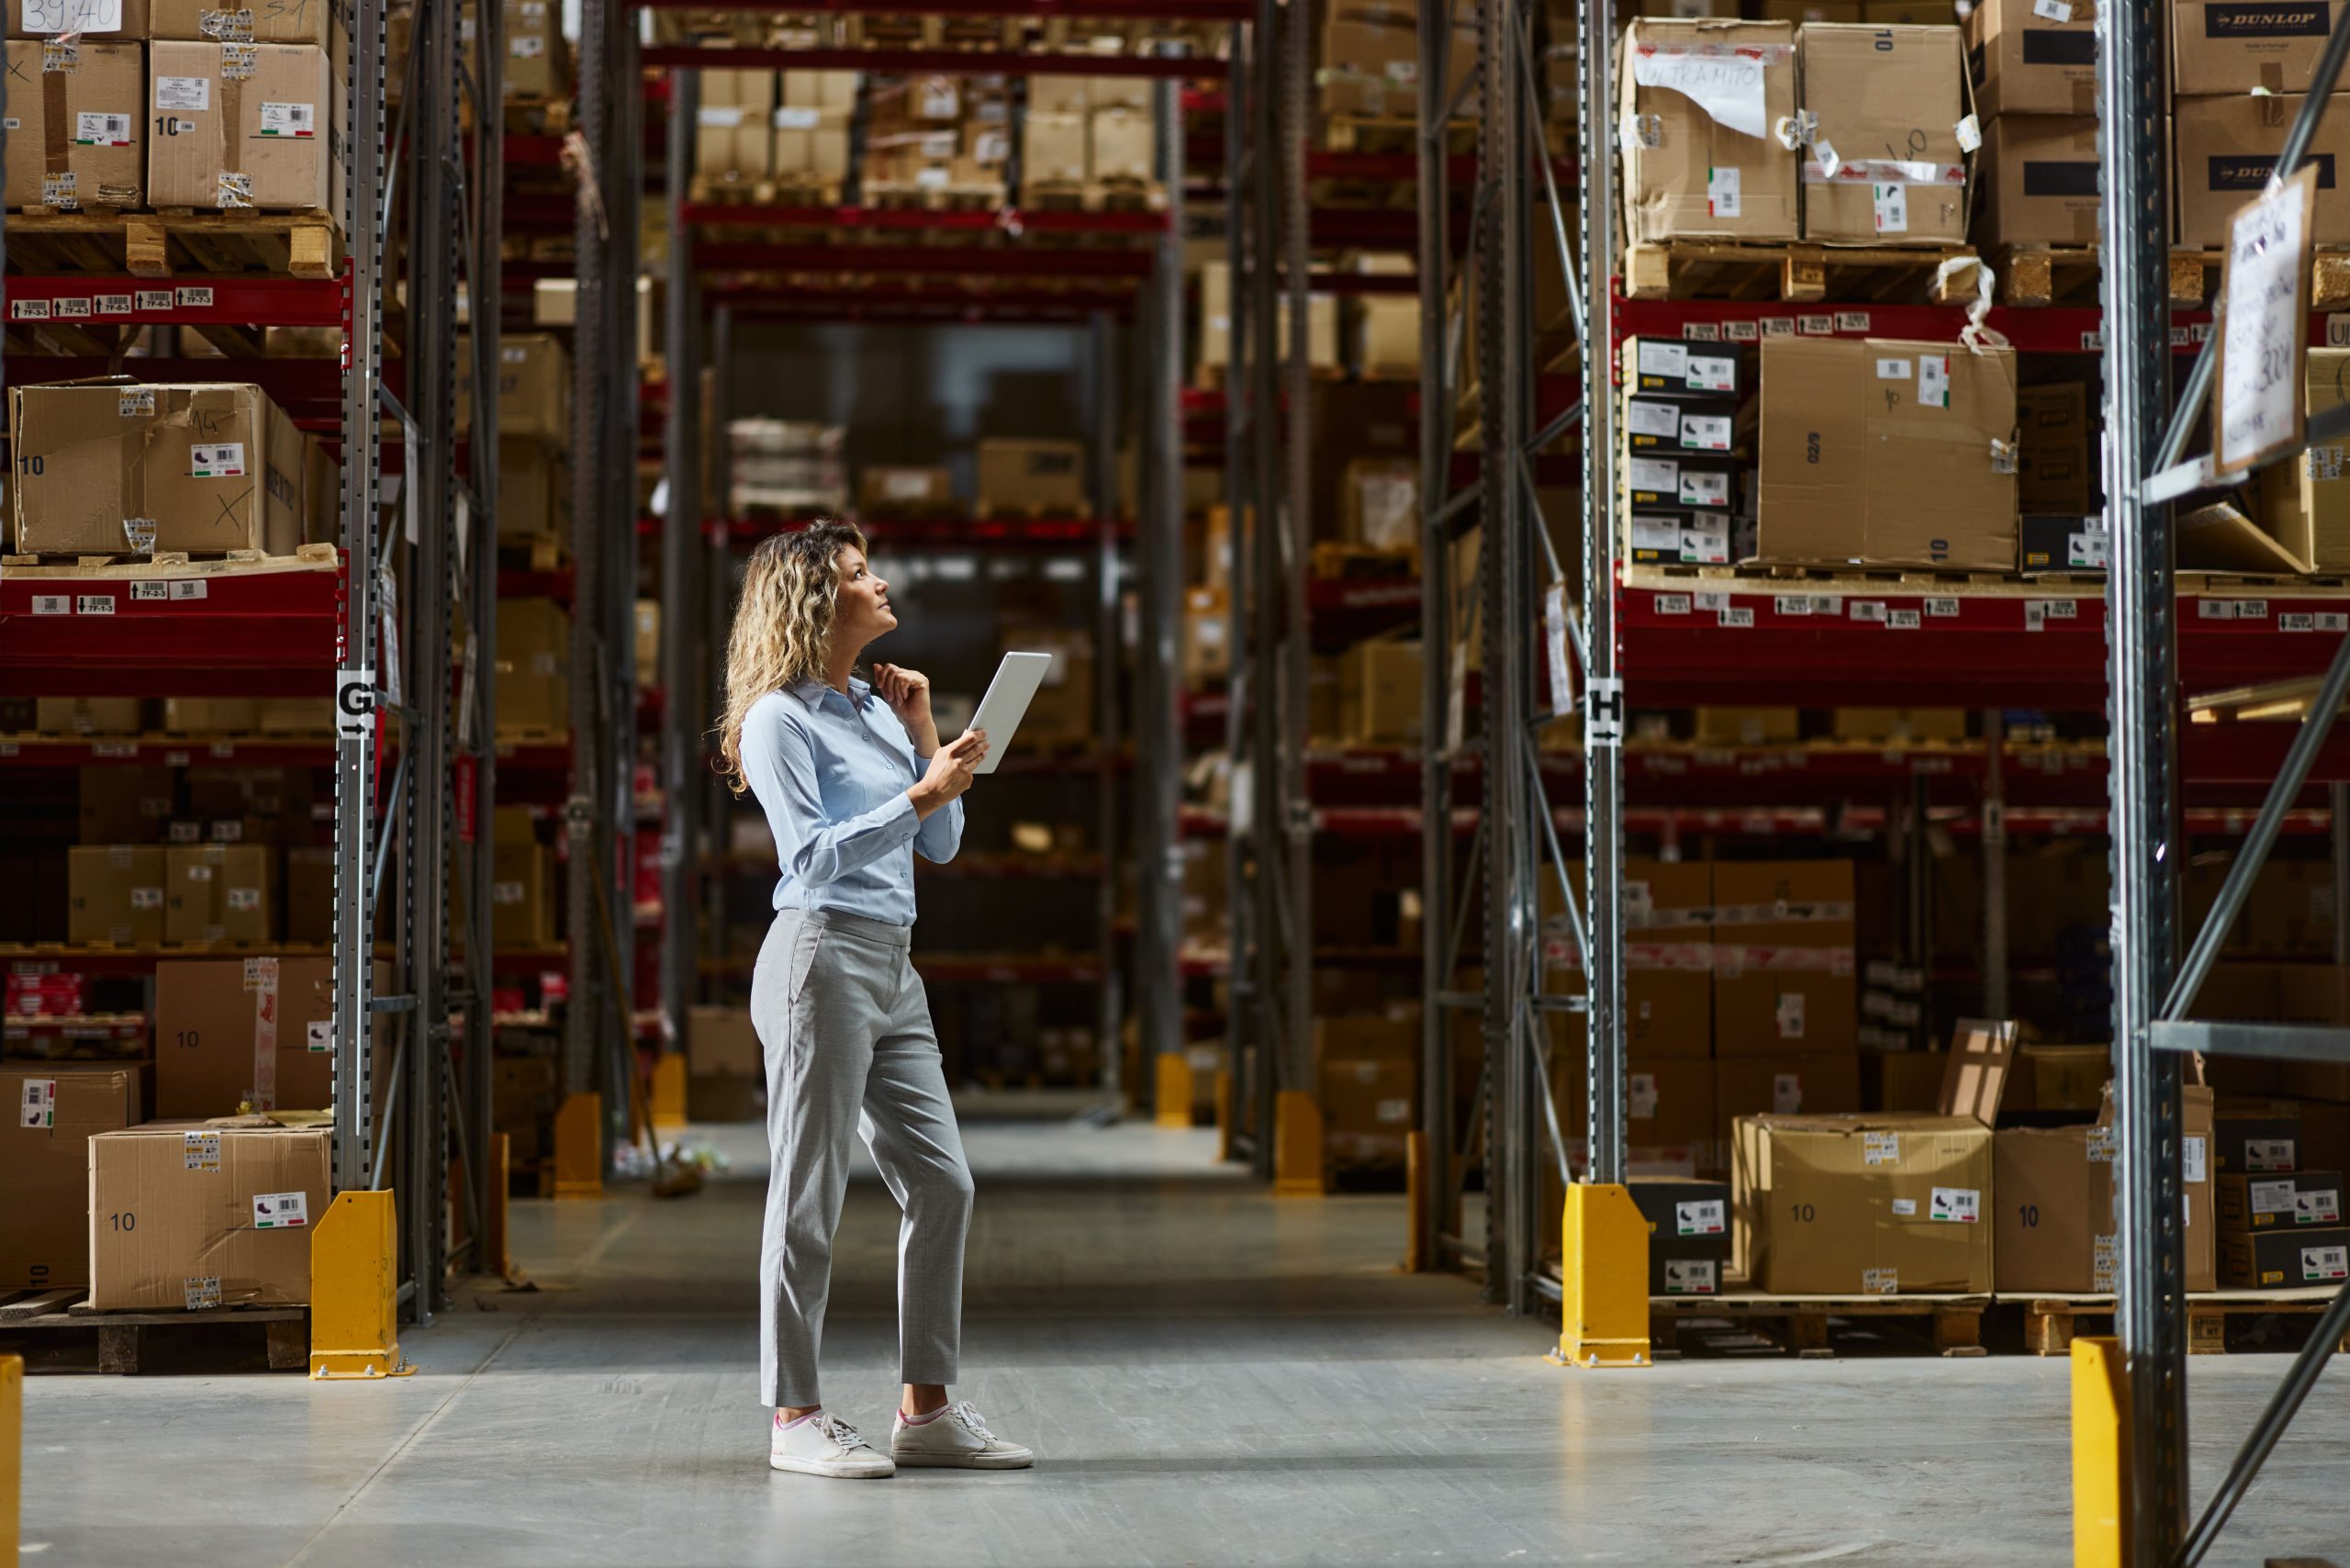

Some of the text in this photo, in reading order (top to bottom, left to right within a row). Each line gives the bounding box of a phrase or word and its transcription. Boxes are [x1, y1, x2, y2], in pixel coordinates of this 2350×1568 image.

[2231, 13, 2317, 25] DUNLOP
[1874, 30, 1893, 51] 10
[155, 117, 179, 136] 10
[18, 455, 44, 476] 10
[1931, 539, 1949, 561] 10
[339, 681, 375, 716] G
[1590, 689, 1621, 722] H
[175, 1030, 199, 1048] 10
[110, 1212, 135, 1231] 10
[1790, 1204, 1814, 1222] 10
[2020, 1204, 2039, 1227] 10
[30, 1265, 49, 1286] 10
